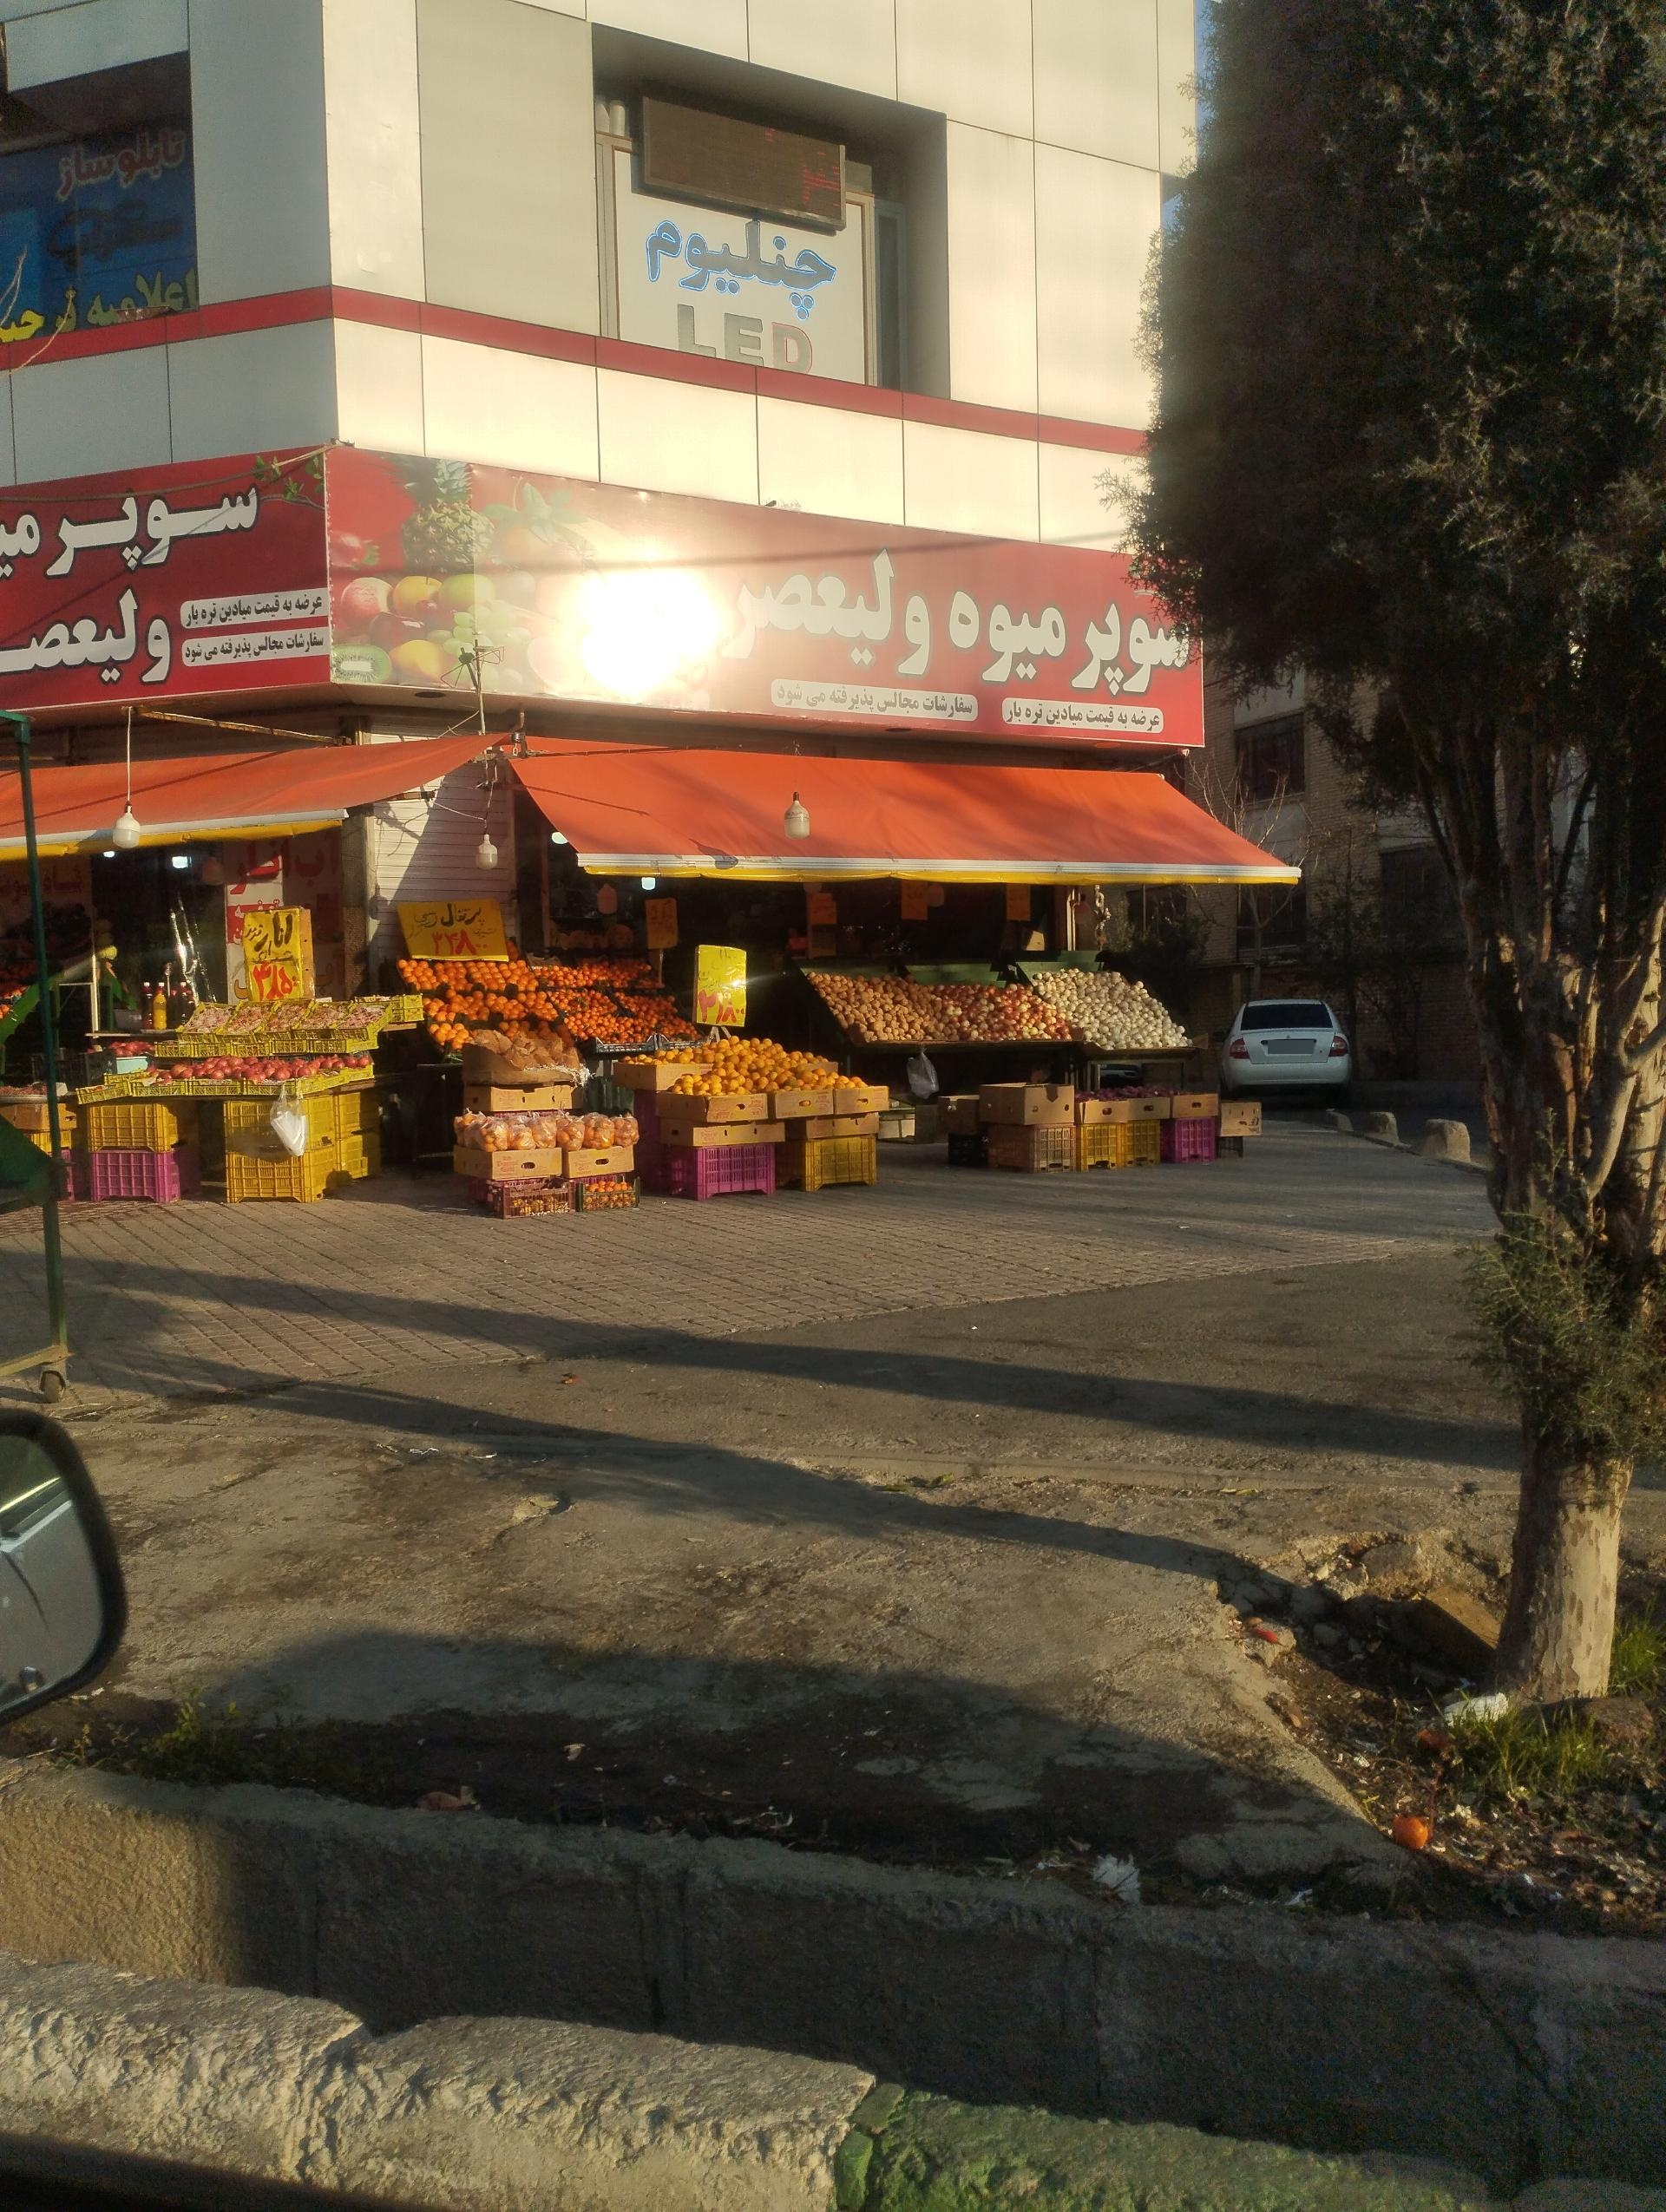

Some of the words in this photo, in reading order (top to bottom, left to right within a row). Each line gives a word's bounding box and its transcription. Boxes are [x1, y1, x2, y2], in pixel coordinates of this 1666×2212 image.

[646, 218, 836, 321] چنلیوم
[677, 304, 813, 375] LED
[46, 485, 258, 577] سوپر
[201, 603, 216, 625] تره
[220, 599, 252, 623] میادین
[254, 595, 279, 617] قیمت
[282, 597, 292, 616] به
[295, 594, 322, 614] عرضه
[186, 605, 199, 626] بار
[0, 588, 171, 683] ولیعص
[253, 636, 284, 656] مجالس
[286, 632, 324, 652] سفارشات
[949, 591, 1066, 682] میوه
[185, 641, 202, 662] شود
[204, 646, 218, 660] می
[220, 638, 252, 658] پذیرفته
[1071, 603, 1190, 695] سوپر
[777, 684, 803, 701] شود
[806, 692, 826, 707] می
[829, 686, 874, 713] پذیرفته
[877, 691, 920, 714] مجالس
[922, 695, 974, 718] سفارشات
[1006, 702, 1022, 723] بار
[1025, 703, 1043, 725] تره
[1046, 704, 1084, 725] میادین
[1086, 706, 1114, 728] قیمت
[1117, 711, 1128, 729] به
[1131, 708, 1160, 731] عرضه
